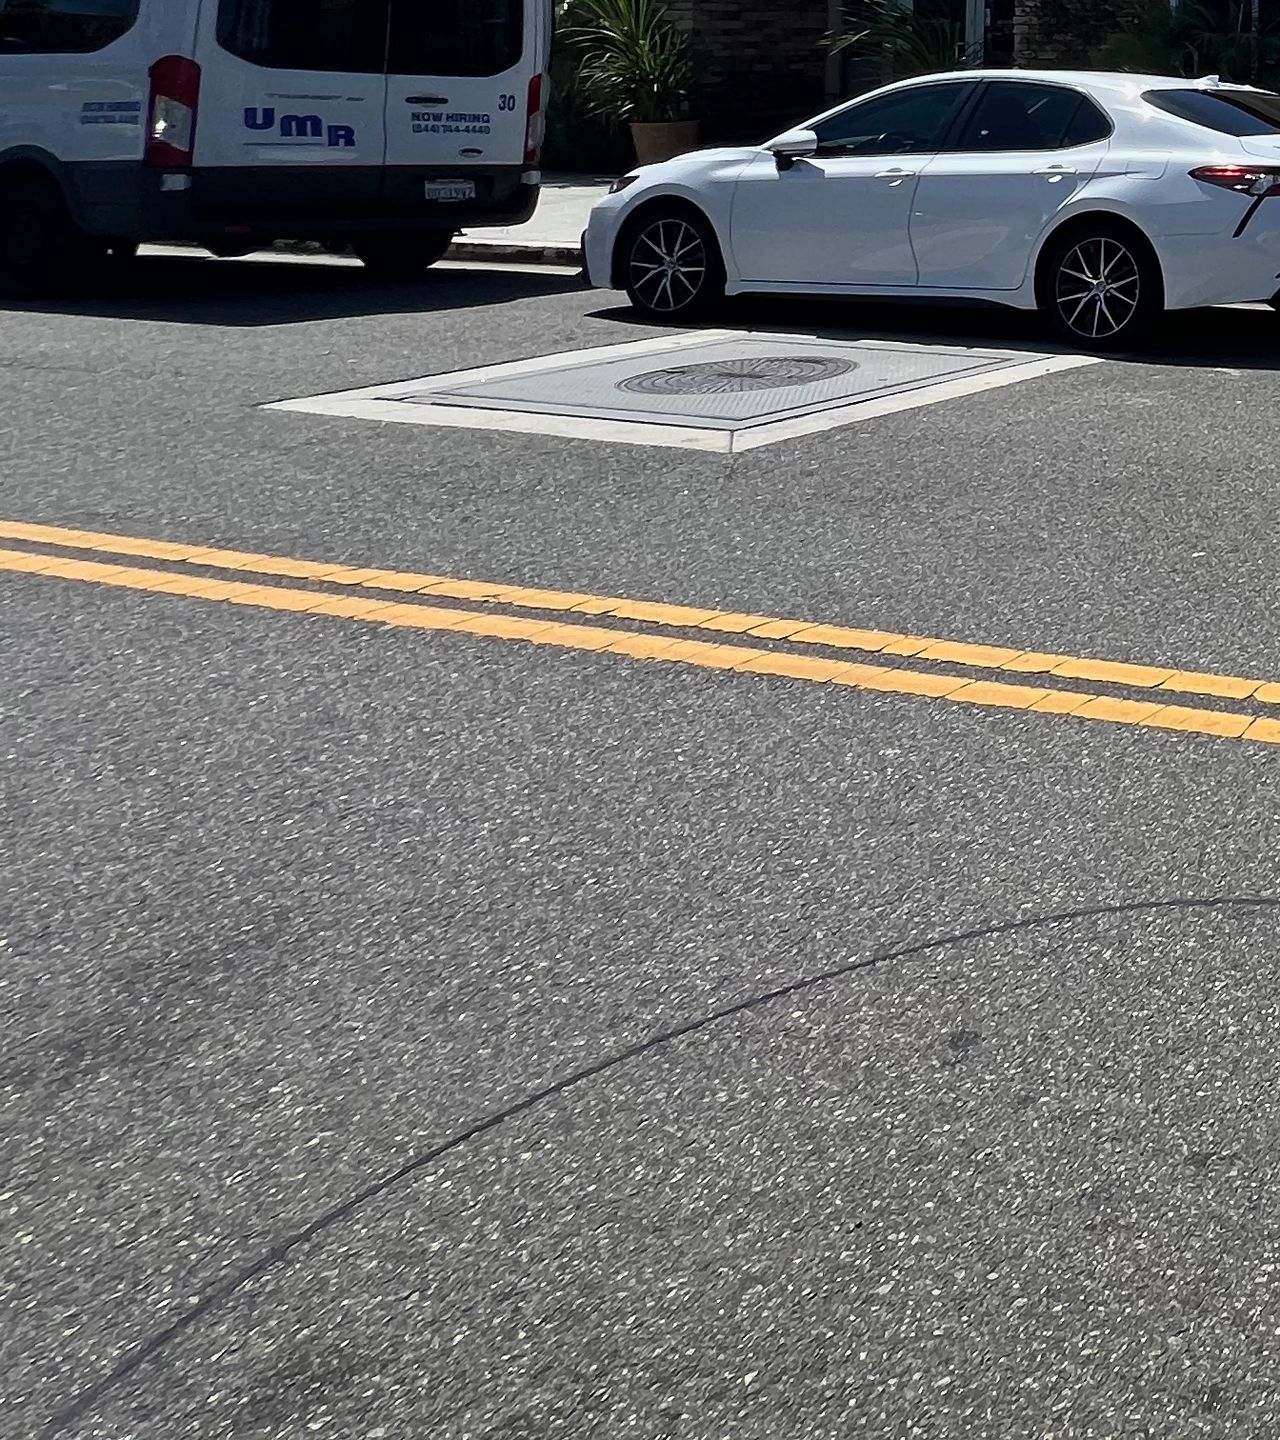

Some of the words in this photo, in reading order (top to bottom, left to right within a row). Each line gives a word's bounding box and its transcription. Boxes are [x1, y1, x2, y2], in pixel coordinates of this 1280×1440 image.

[497, 94, 516, 112] 30
[411, 112, 443, 122] NOW
[446, 113, 491, 124] HIRING
